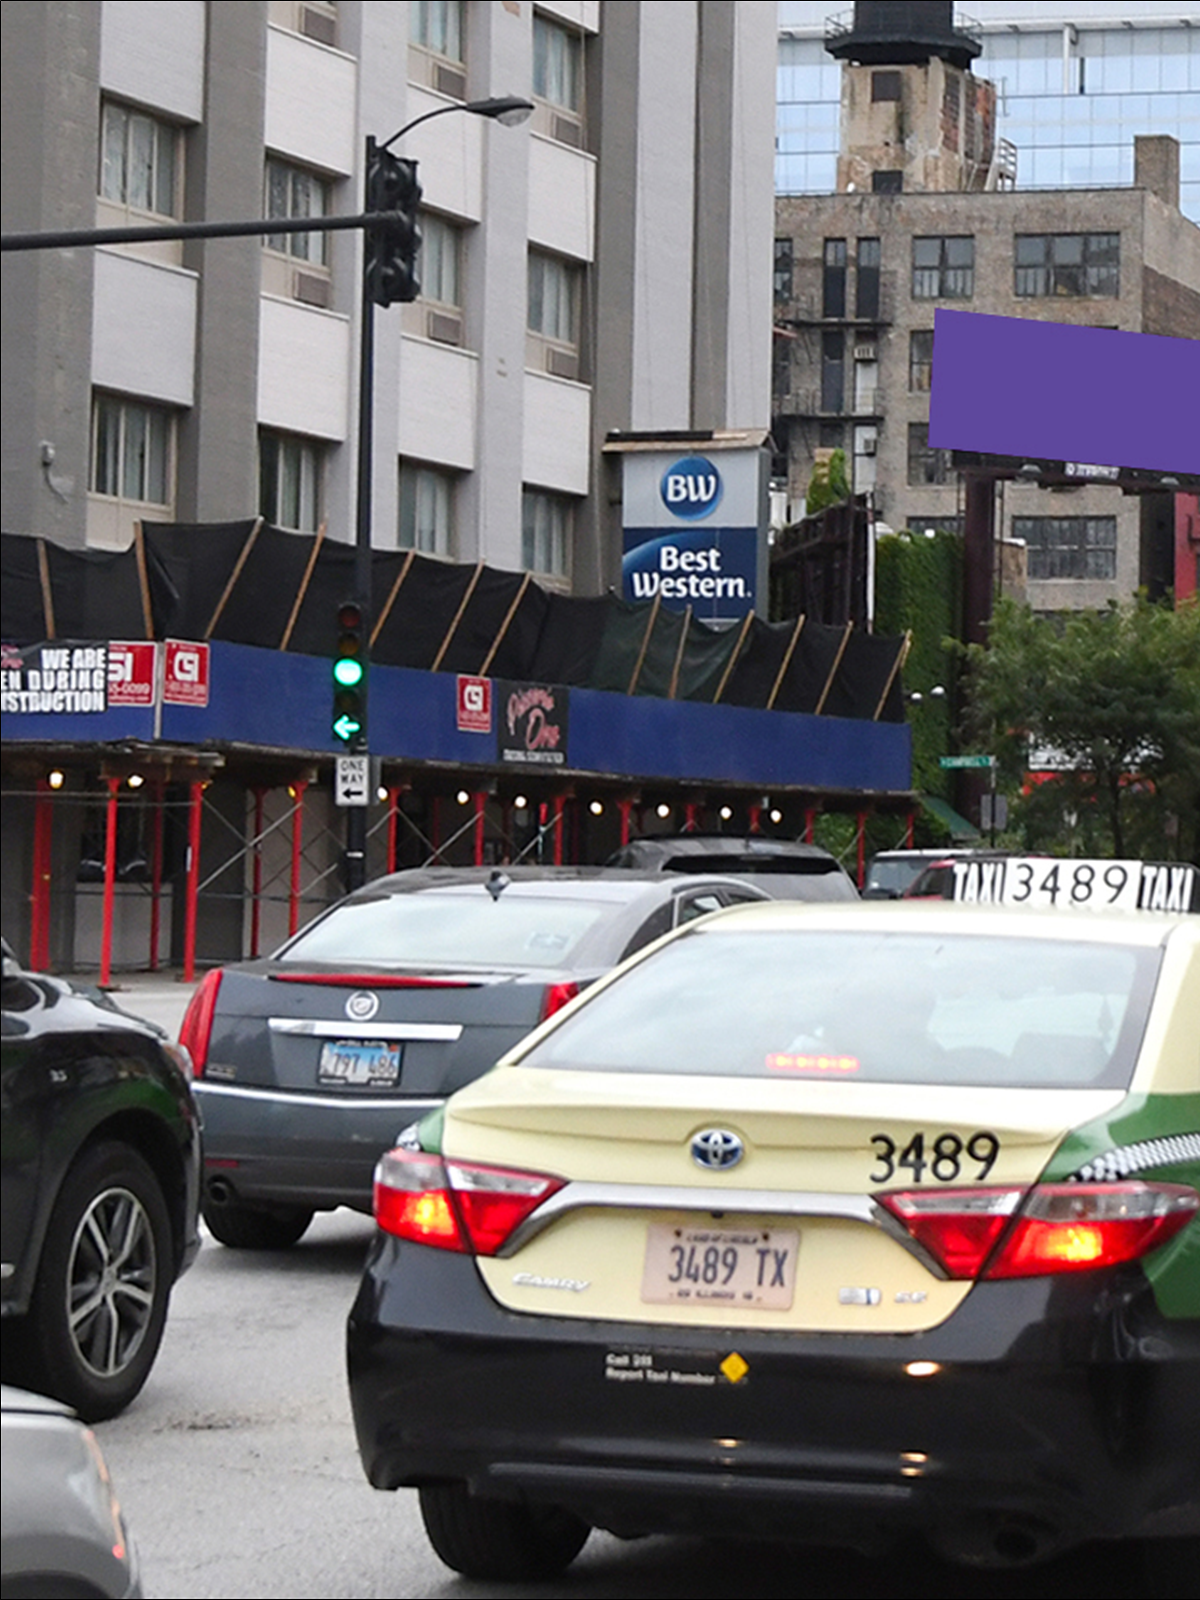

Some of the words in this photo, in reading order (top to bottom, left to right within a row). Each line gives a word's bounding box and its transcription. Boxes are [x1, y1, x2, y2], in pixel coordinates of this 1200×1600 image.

[667, 475, 716, 502] BW
[660, 546, 721, 571] Best
[41, 649, 70, 669] WE
[72, 648, 106, 669] ARE
[28, 670, 105, 691] DURING
[341, 760, 363, 771] ONE
[341, 774, 363, 783] WAY
[953, 863, 1004, 903] TAXI
[1012, 863, 1129, 904] 3489
[1142, 866, 1194, 912] TAXI
[869, 1131, 1000, 1183] 3489
[668, 1245, 738, 1284] 3489
[756, 1248, 788, 1287] TX
